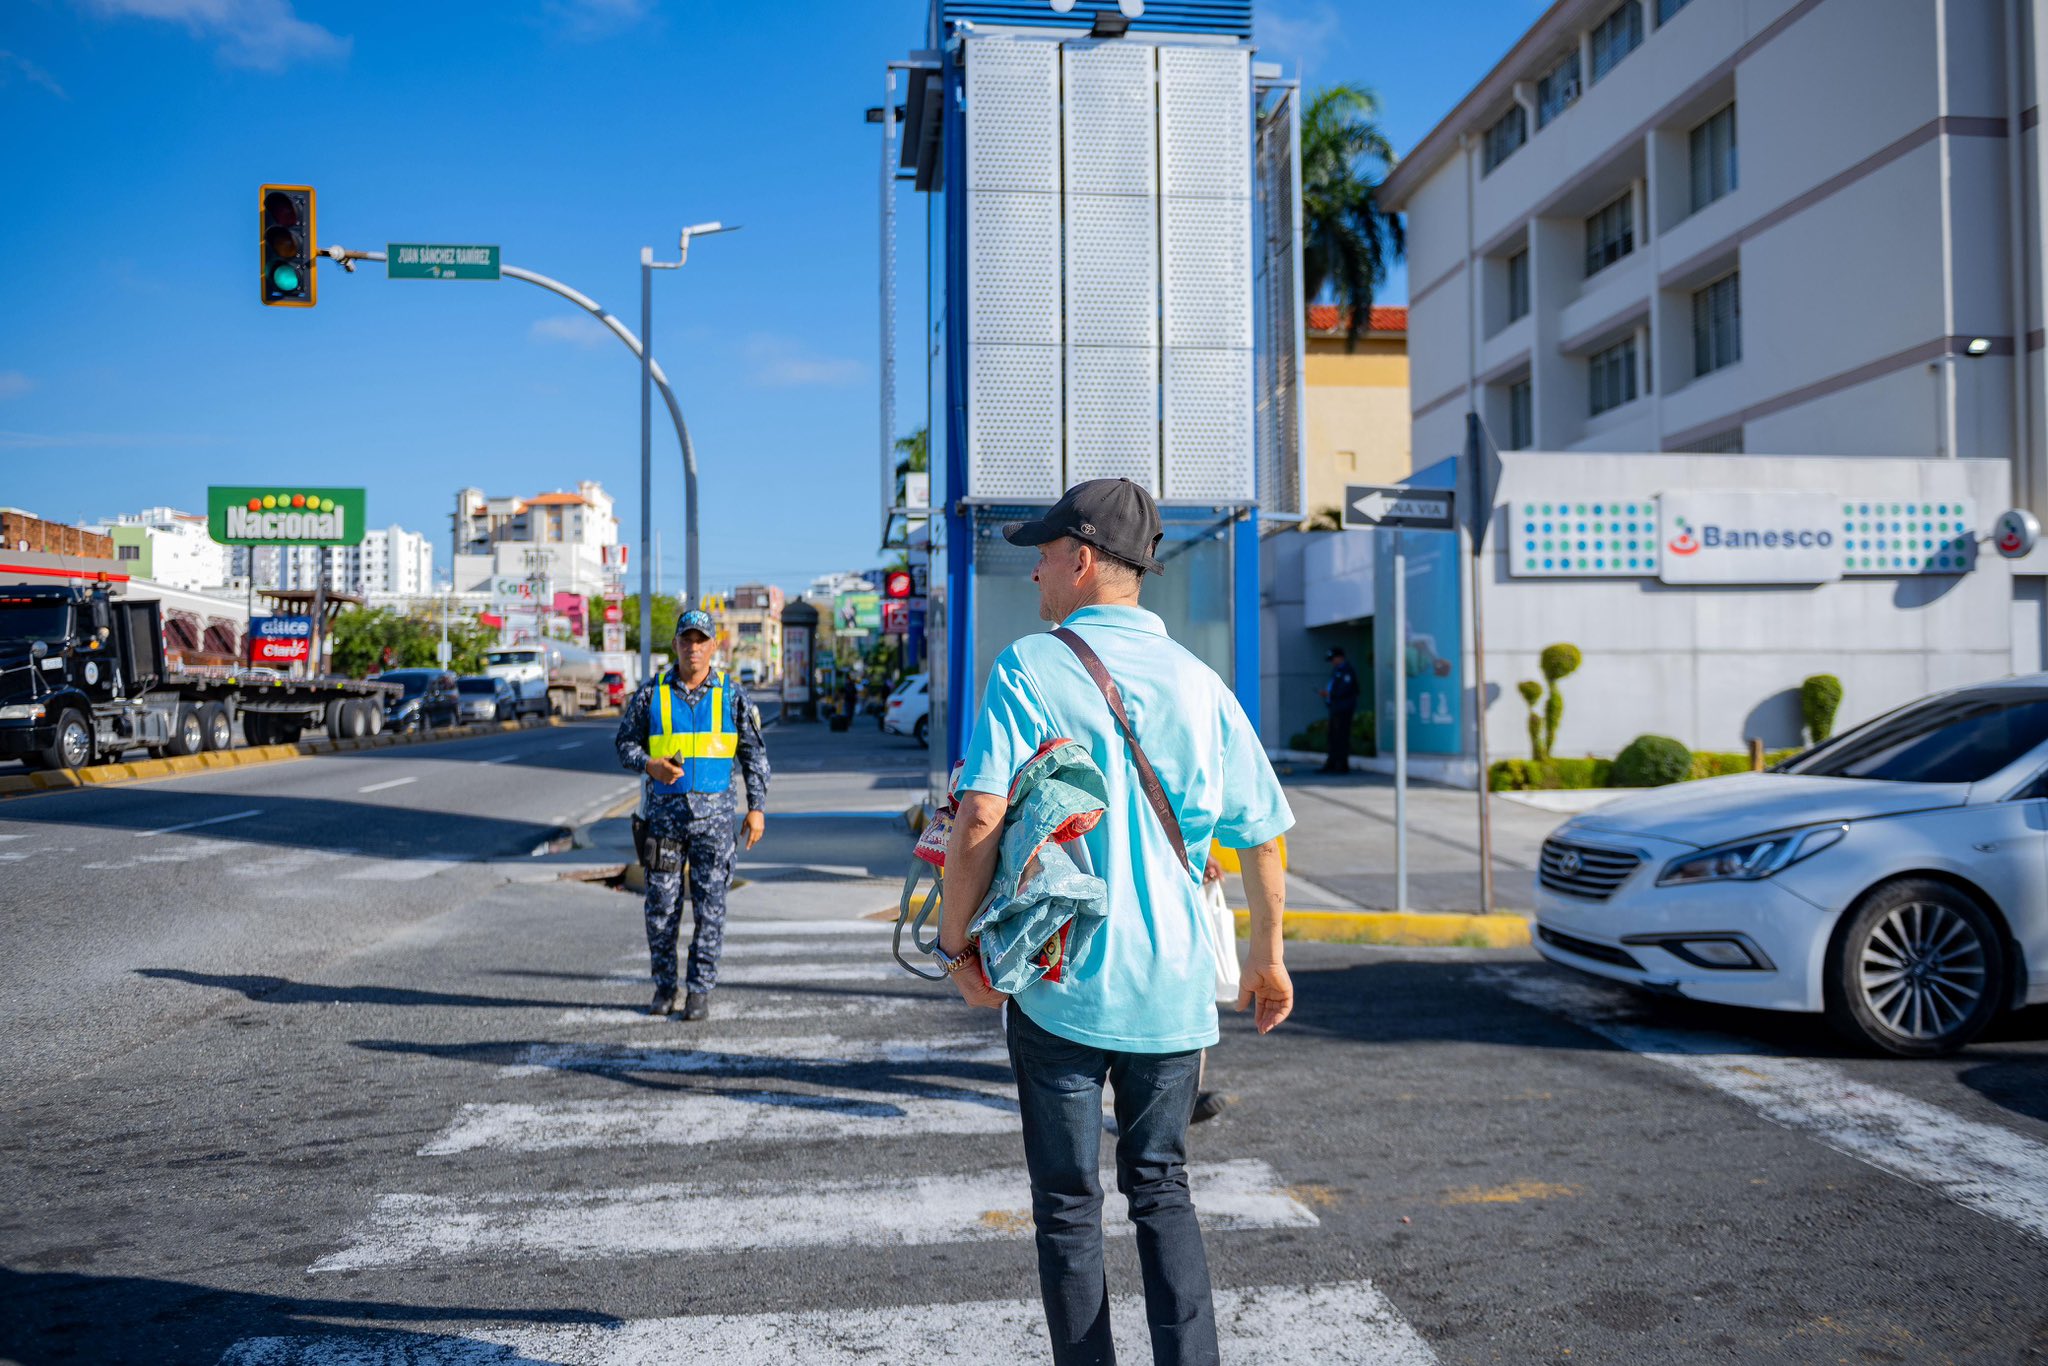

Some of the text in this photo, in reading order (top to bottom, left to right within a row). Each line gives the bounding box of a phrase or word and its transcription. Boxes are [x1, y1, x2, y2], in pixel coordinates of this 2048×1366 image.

[397, 247, 419, 264] JUAN
[227, 505, 344, 539] Nacional
[1703, 526, 1833, 547] Banesco
